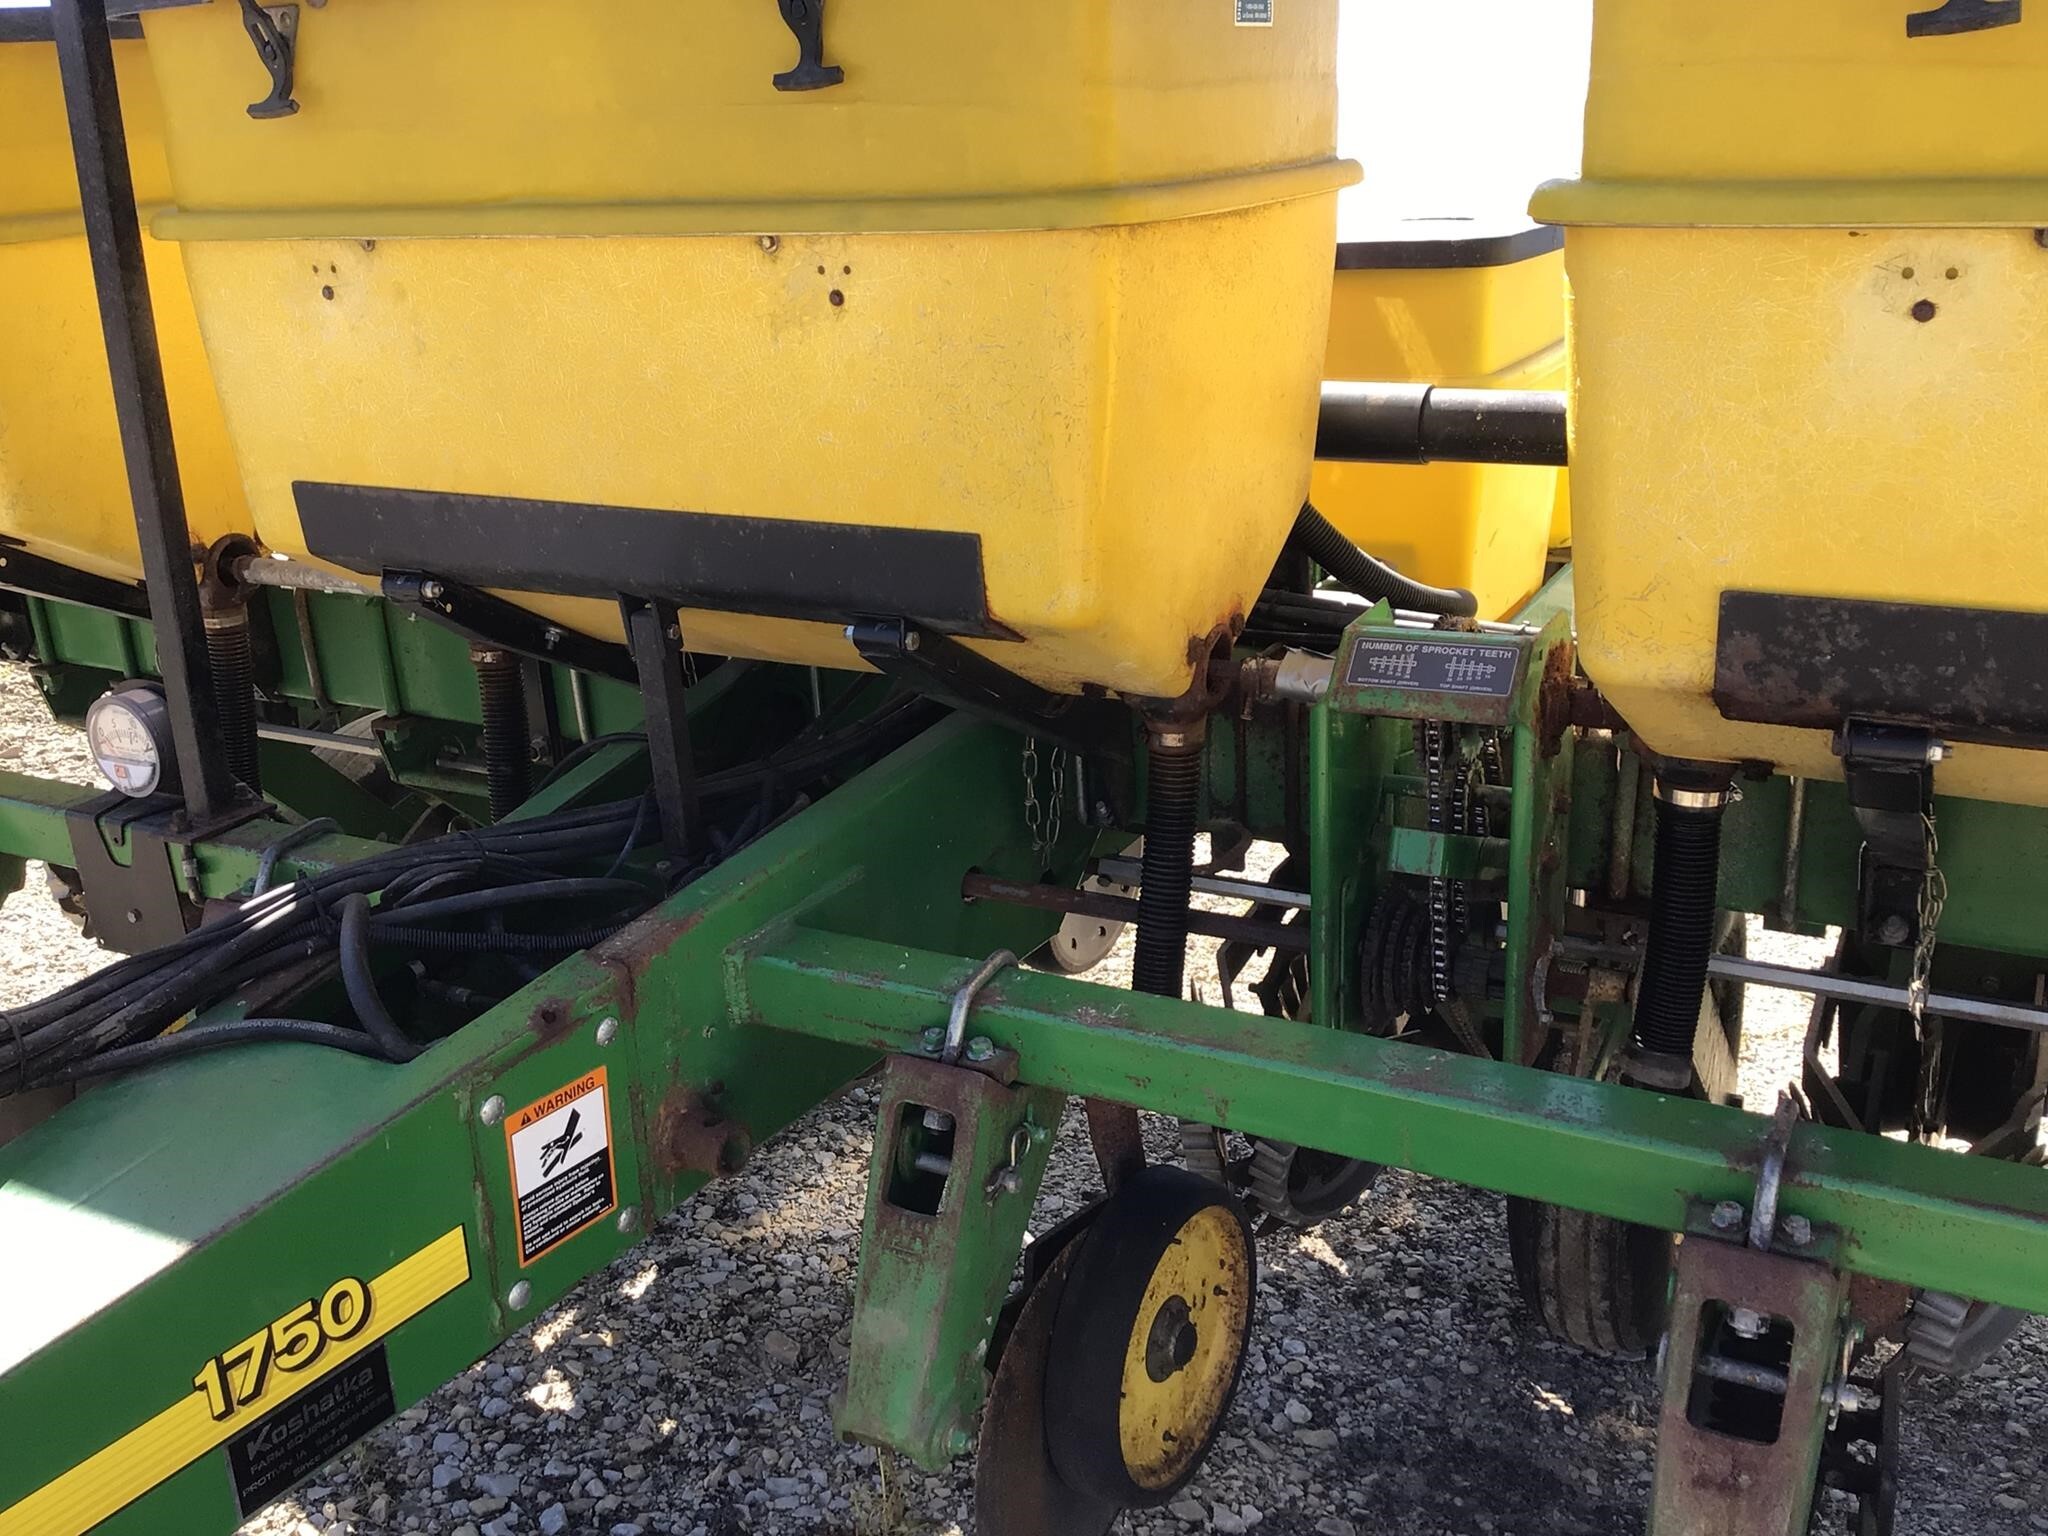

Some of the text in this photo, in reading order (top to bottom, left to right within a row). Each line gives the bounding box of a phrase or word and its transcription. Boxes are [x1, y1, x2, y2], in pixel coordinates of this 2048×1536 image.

[1361, 641, 1512, 659] NUMBER OF SPROCKET TEETH
[533, 1077, 595, 1118] WARNING
[193, 1276, 371, 1421] 1750
[246, 1367, 374, 1462] Koshatka
